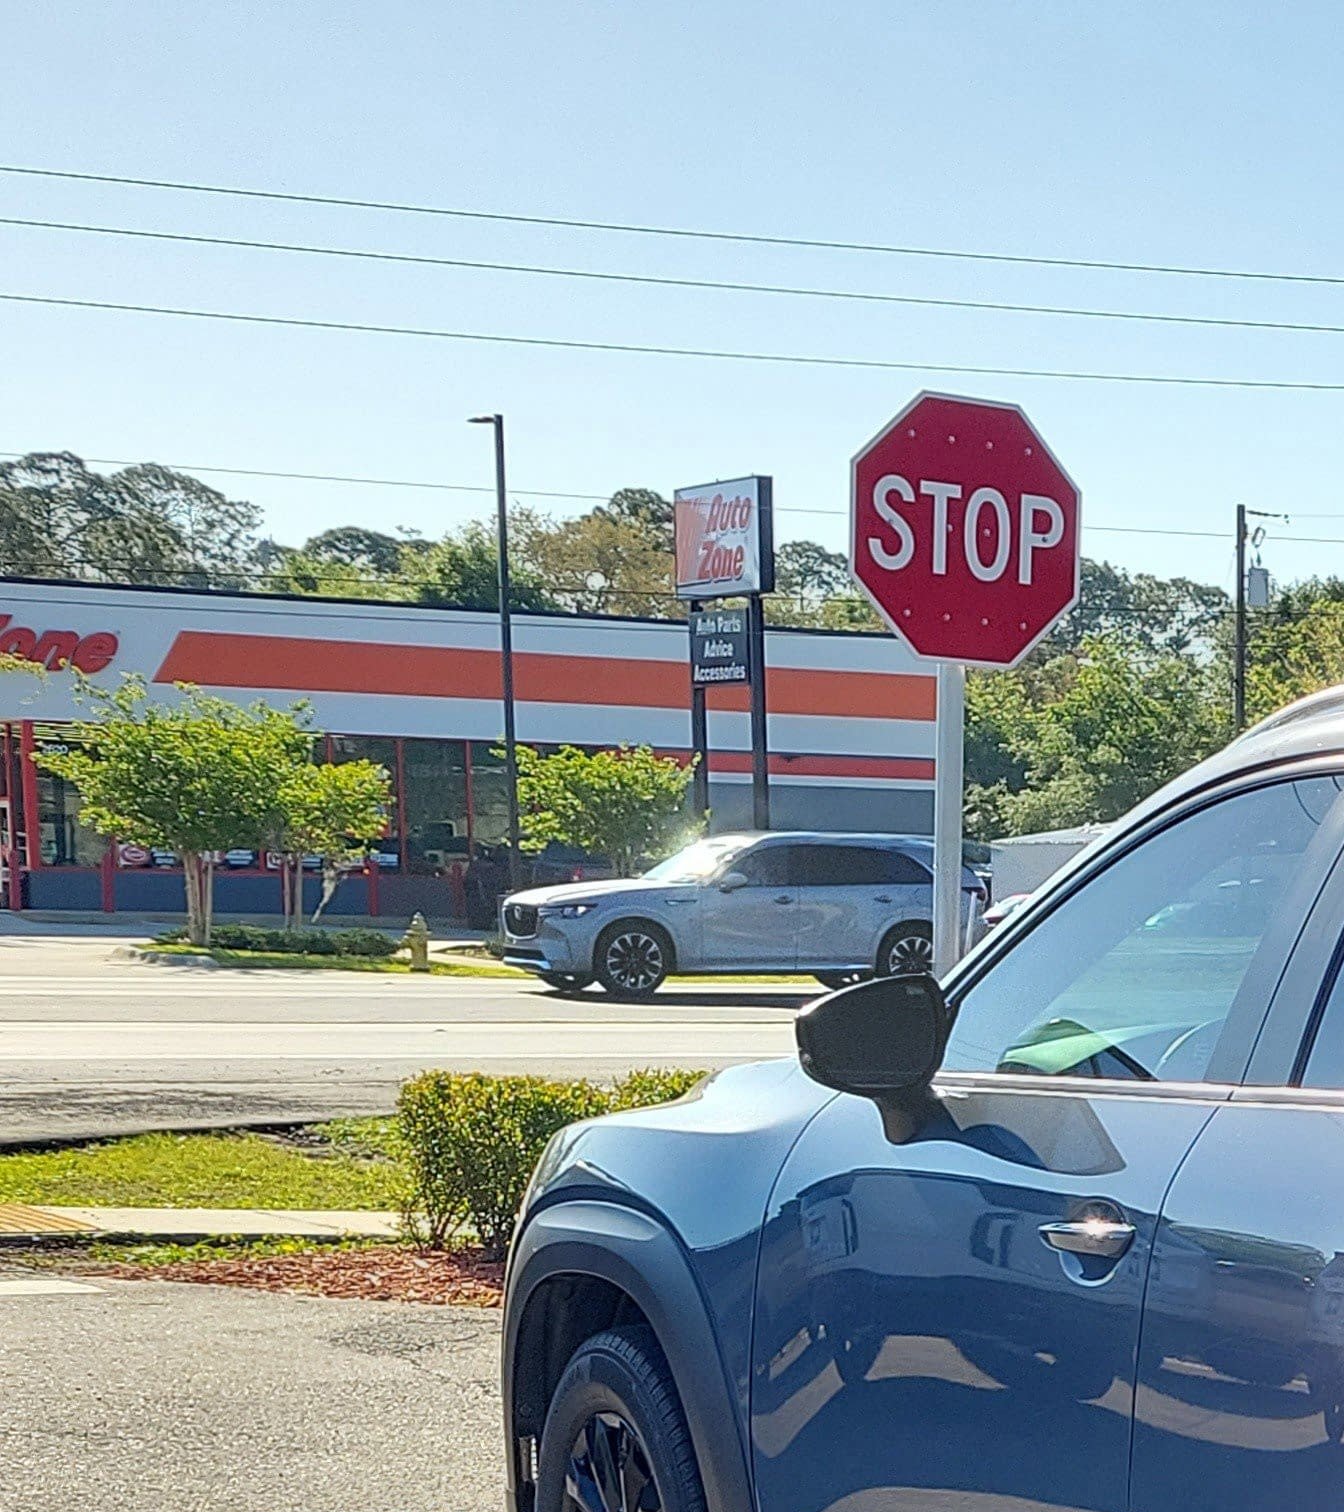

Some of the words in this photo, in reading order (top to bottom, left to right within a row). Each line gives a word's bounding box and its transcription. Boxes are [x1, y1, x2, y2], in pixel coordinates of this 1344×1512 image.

[705, 493, 752, 533] Auto
[868, 474, 1065, 586] STOP
[698, 541, 745, 580] Zone
[0, 614, 118, 674] one
[696, 617, 716, 634] Auto
[717, 616, 742, 633] Parts
[704, 640, 734, 658] Advice
[693, 662, 746, 682] Accessories
